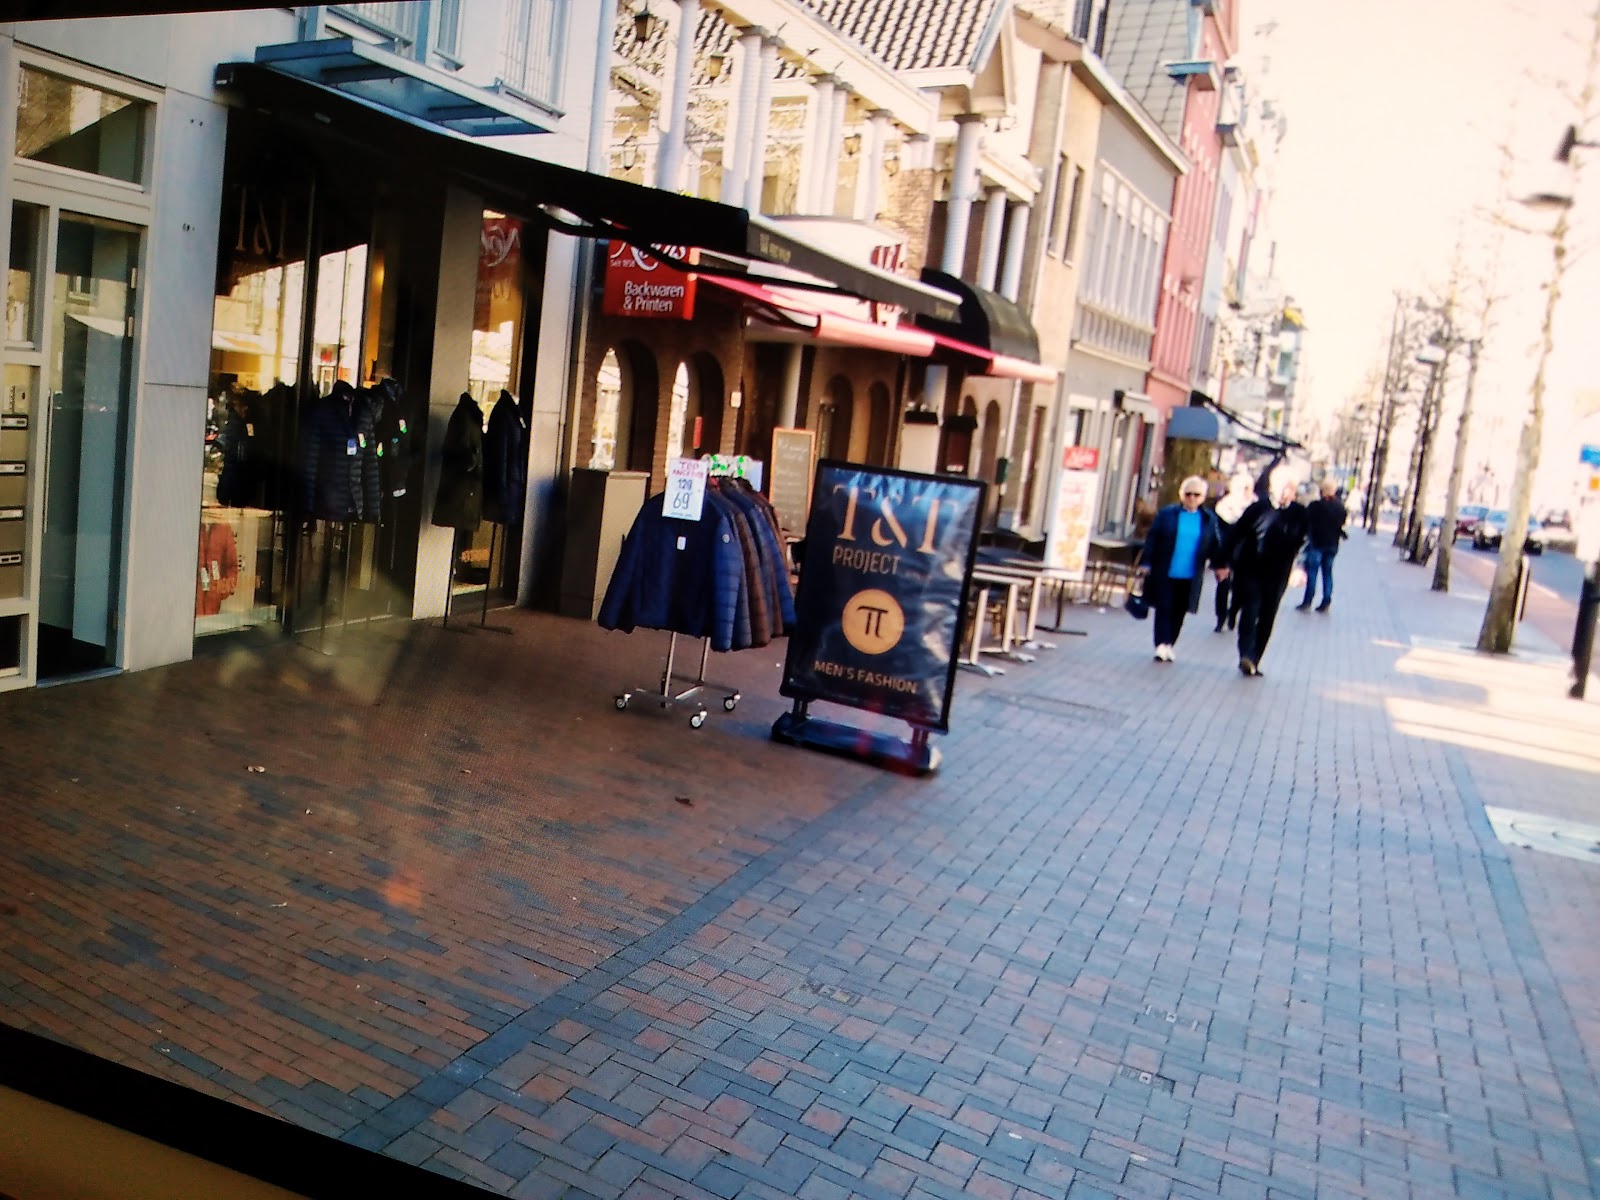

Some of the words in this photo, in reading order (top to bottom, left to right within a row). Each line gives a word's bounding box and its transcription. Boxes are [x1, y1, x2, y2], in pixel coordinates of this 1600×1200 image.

[624, 280, 684, 298] Backwaren
[623, 296, 633, 310] &
[635, 296, 673, 312] Printen
[673, 492, 690, 510] 69
[833, 484, 957, 554] T&T
[832, 545, 900, 575] PROJECT
[813, 659, 855, 681] MEN'S
[857, 668, 919, 694] FASHION
